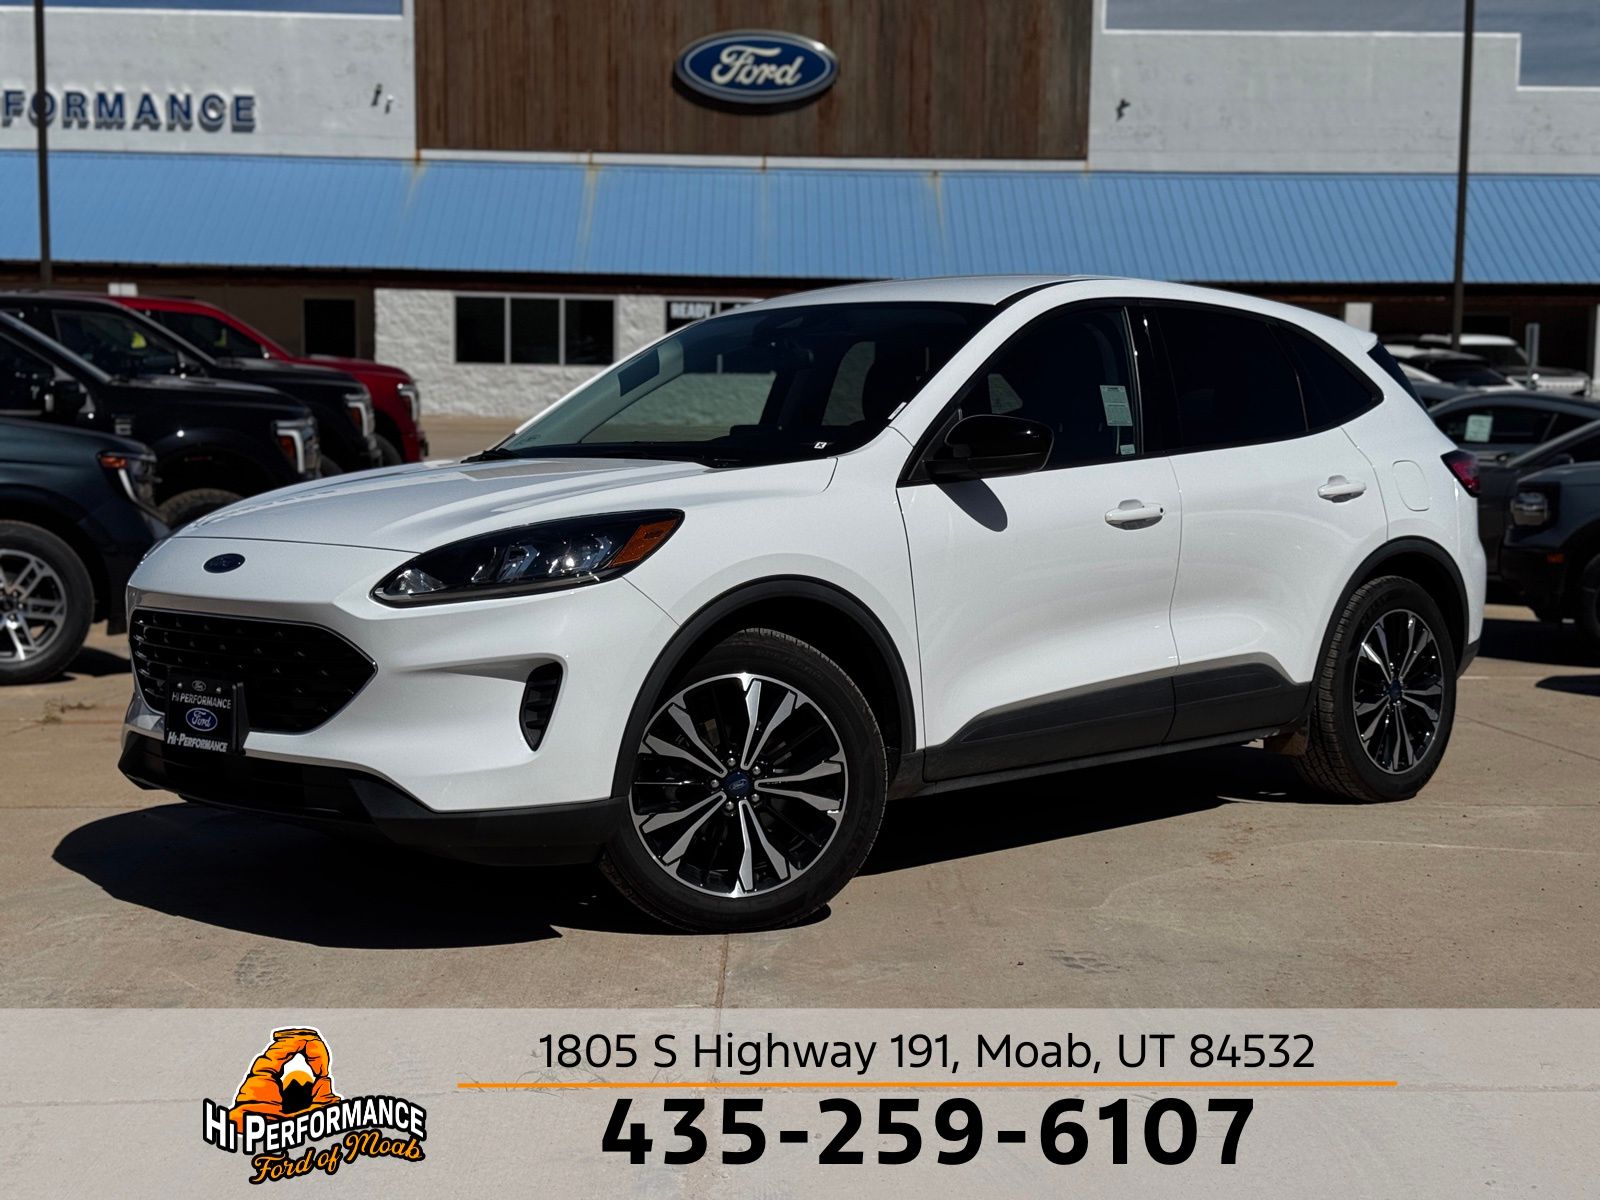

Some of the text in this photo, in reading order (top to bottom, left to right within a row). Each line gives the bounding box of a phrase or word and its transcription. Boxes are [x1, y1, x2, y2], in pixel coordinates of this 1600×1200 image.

[711, 45, 804, 85] Ford
[2, 90, 255, 126] FORMANCE
[180, 693, 231, 709] PERFORMANCE
[191, 710, 212, 728] Ford
